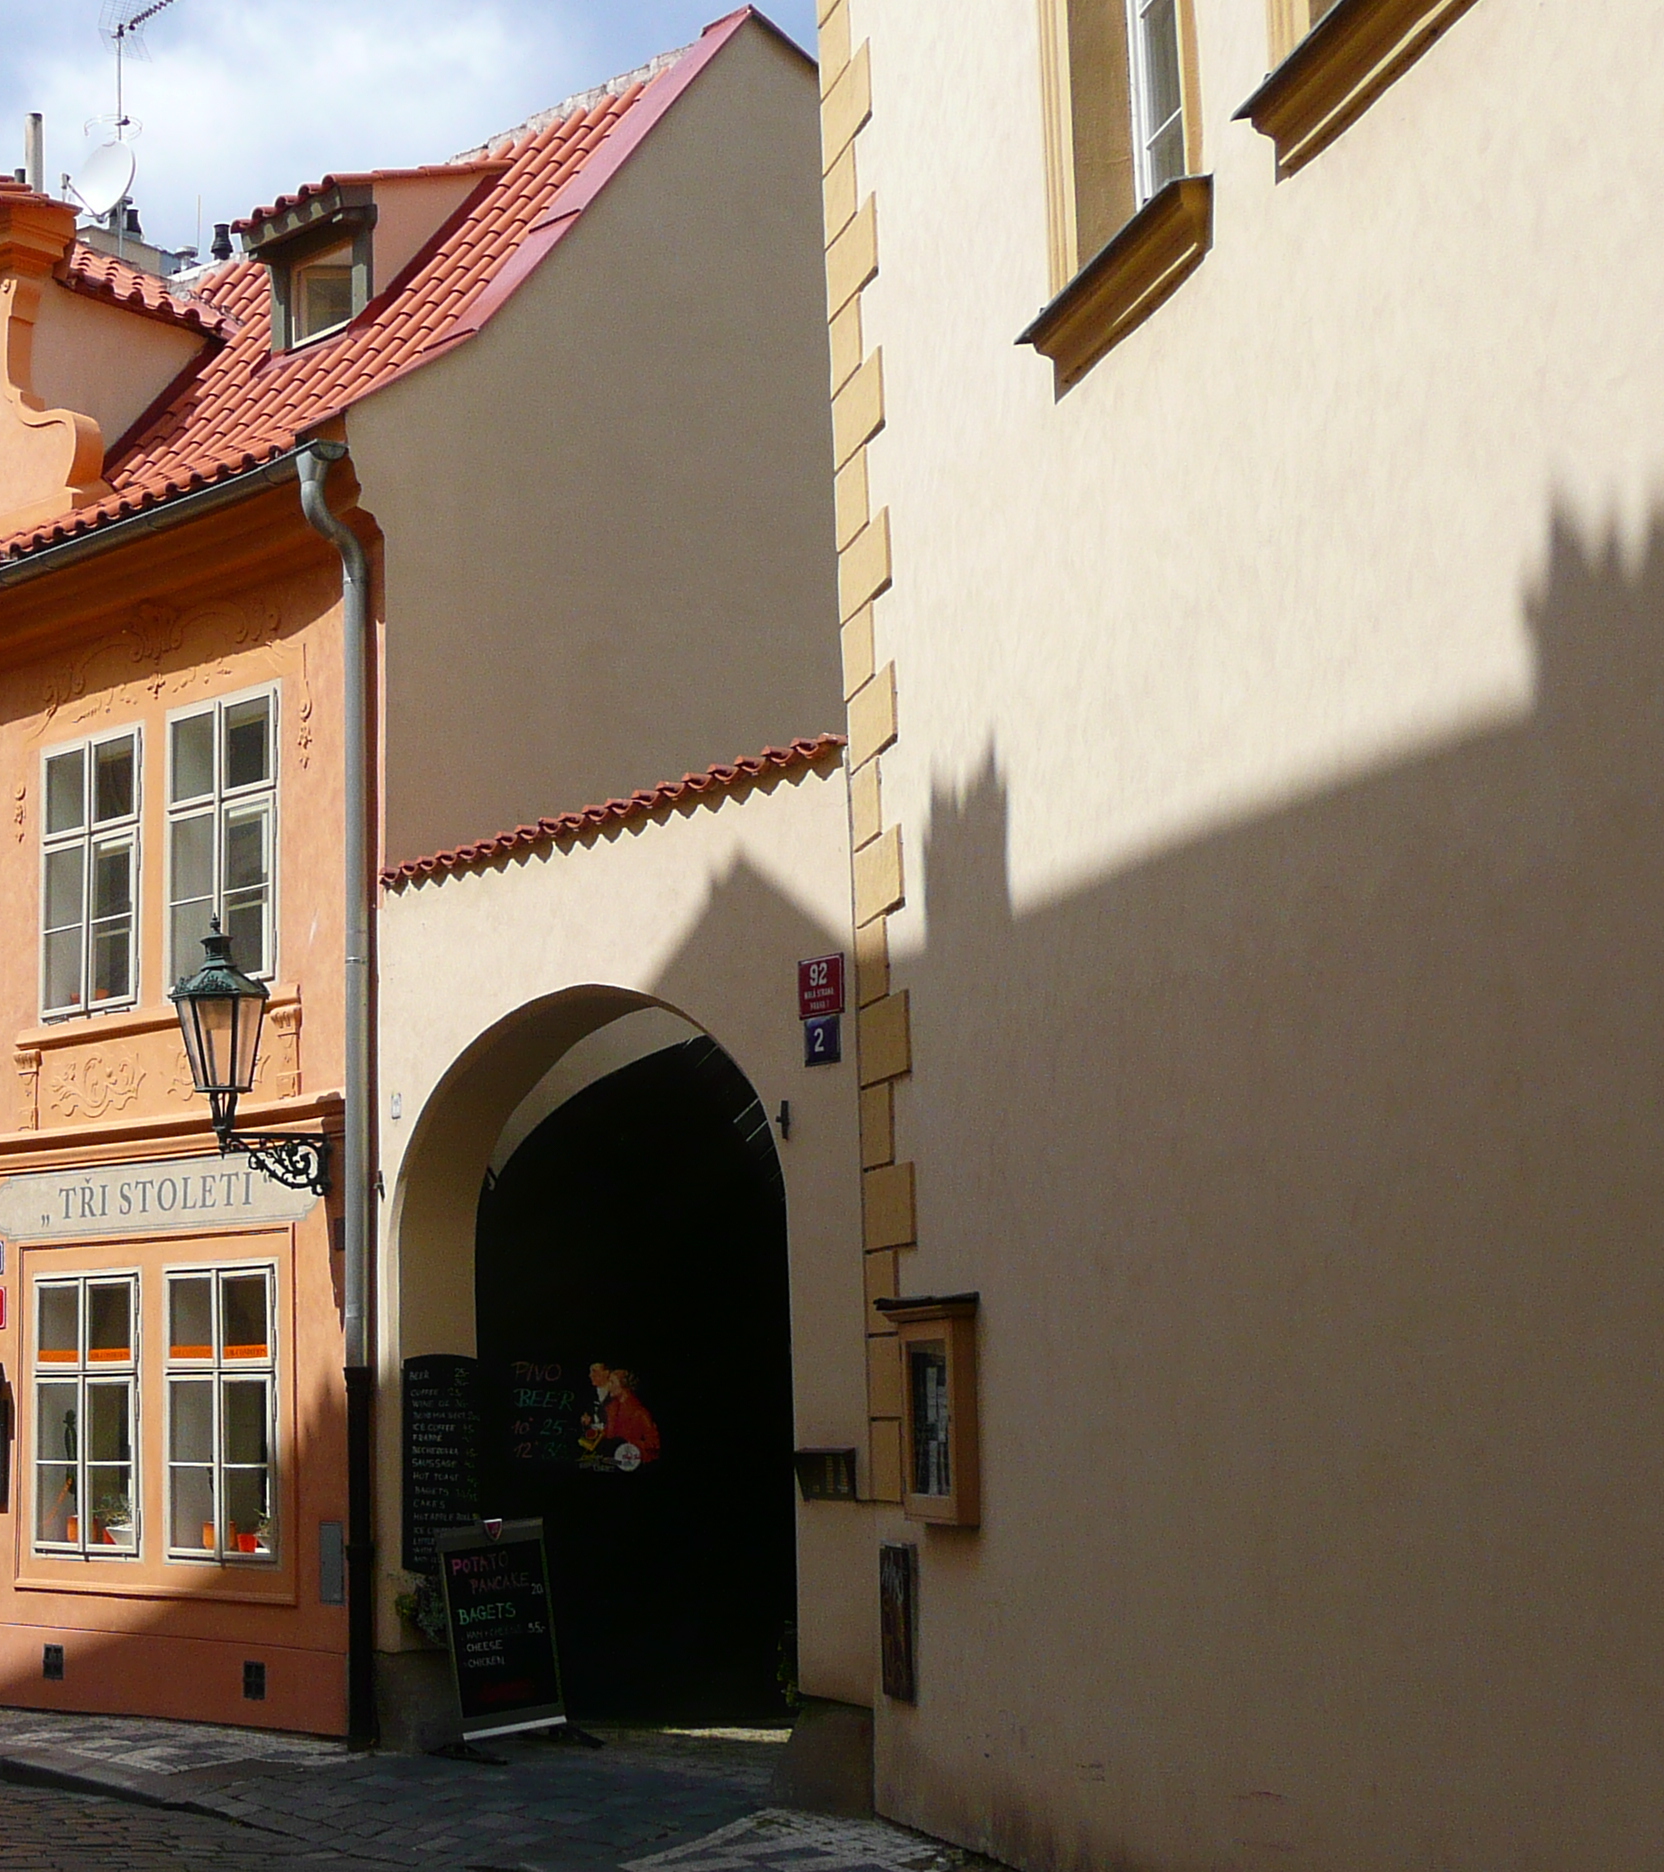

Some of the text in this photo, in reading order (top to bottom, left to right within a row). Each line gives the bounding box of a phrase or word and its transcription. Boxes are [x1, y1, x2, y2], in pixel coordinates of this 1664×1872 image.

[809, 962, 828, 987] 92
[813, 1028, 824, 1053] 2
[510, 1361, 562, 1382] PIVO
[512, 1388, 576, 1411] BEER
[451, 1550, 509, 1576] POTATO
[469, 1571, 530, 1595] PANCAKE
[456, 1601, 516, 1625] BAGETS
[466, 1639, 503, 1653] CHEESE
[467, 1655, 506, 1668] CHICKEN
